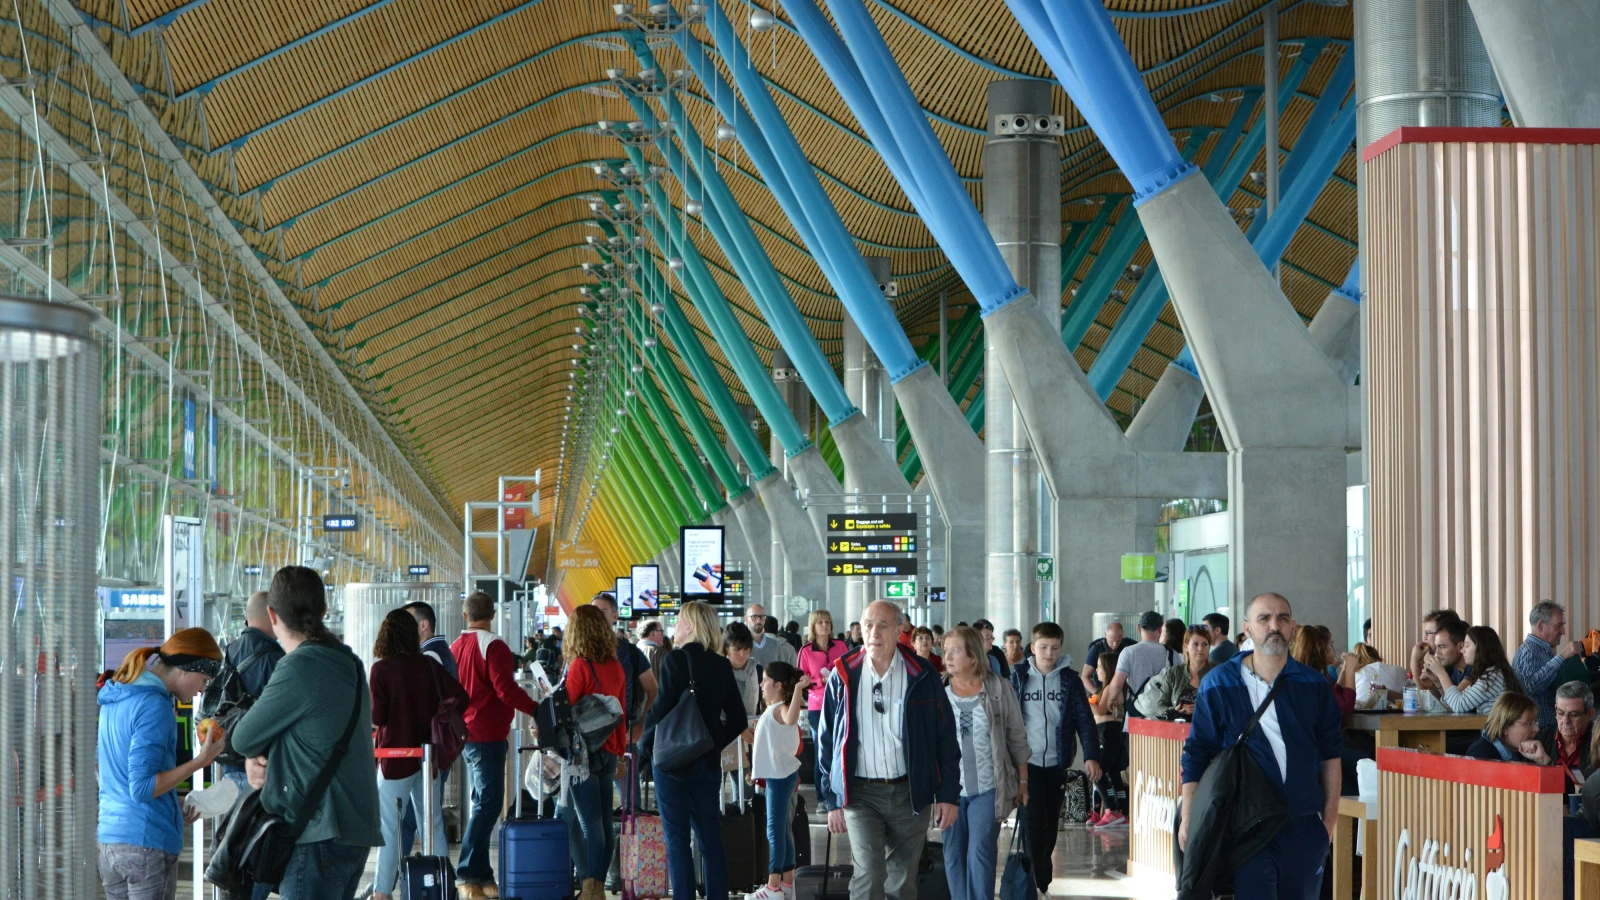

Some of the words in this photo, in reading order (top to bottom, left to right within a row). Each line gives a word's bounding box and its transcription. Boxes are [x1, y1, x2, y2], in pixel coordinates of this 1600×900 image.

[560, 559, 576, 567] J40
[583, 558, 599, 567] J59
[121, 593, 165, 606] SAMSU
[1023, 690, 1062, 701] adida
